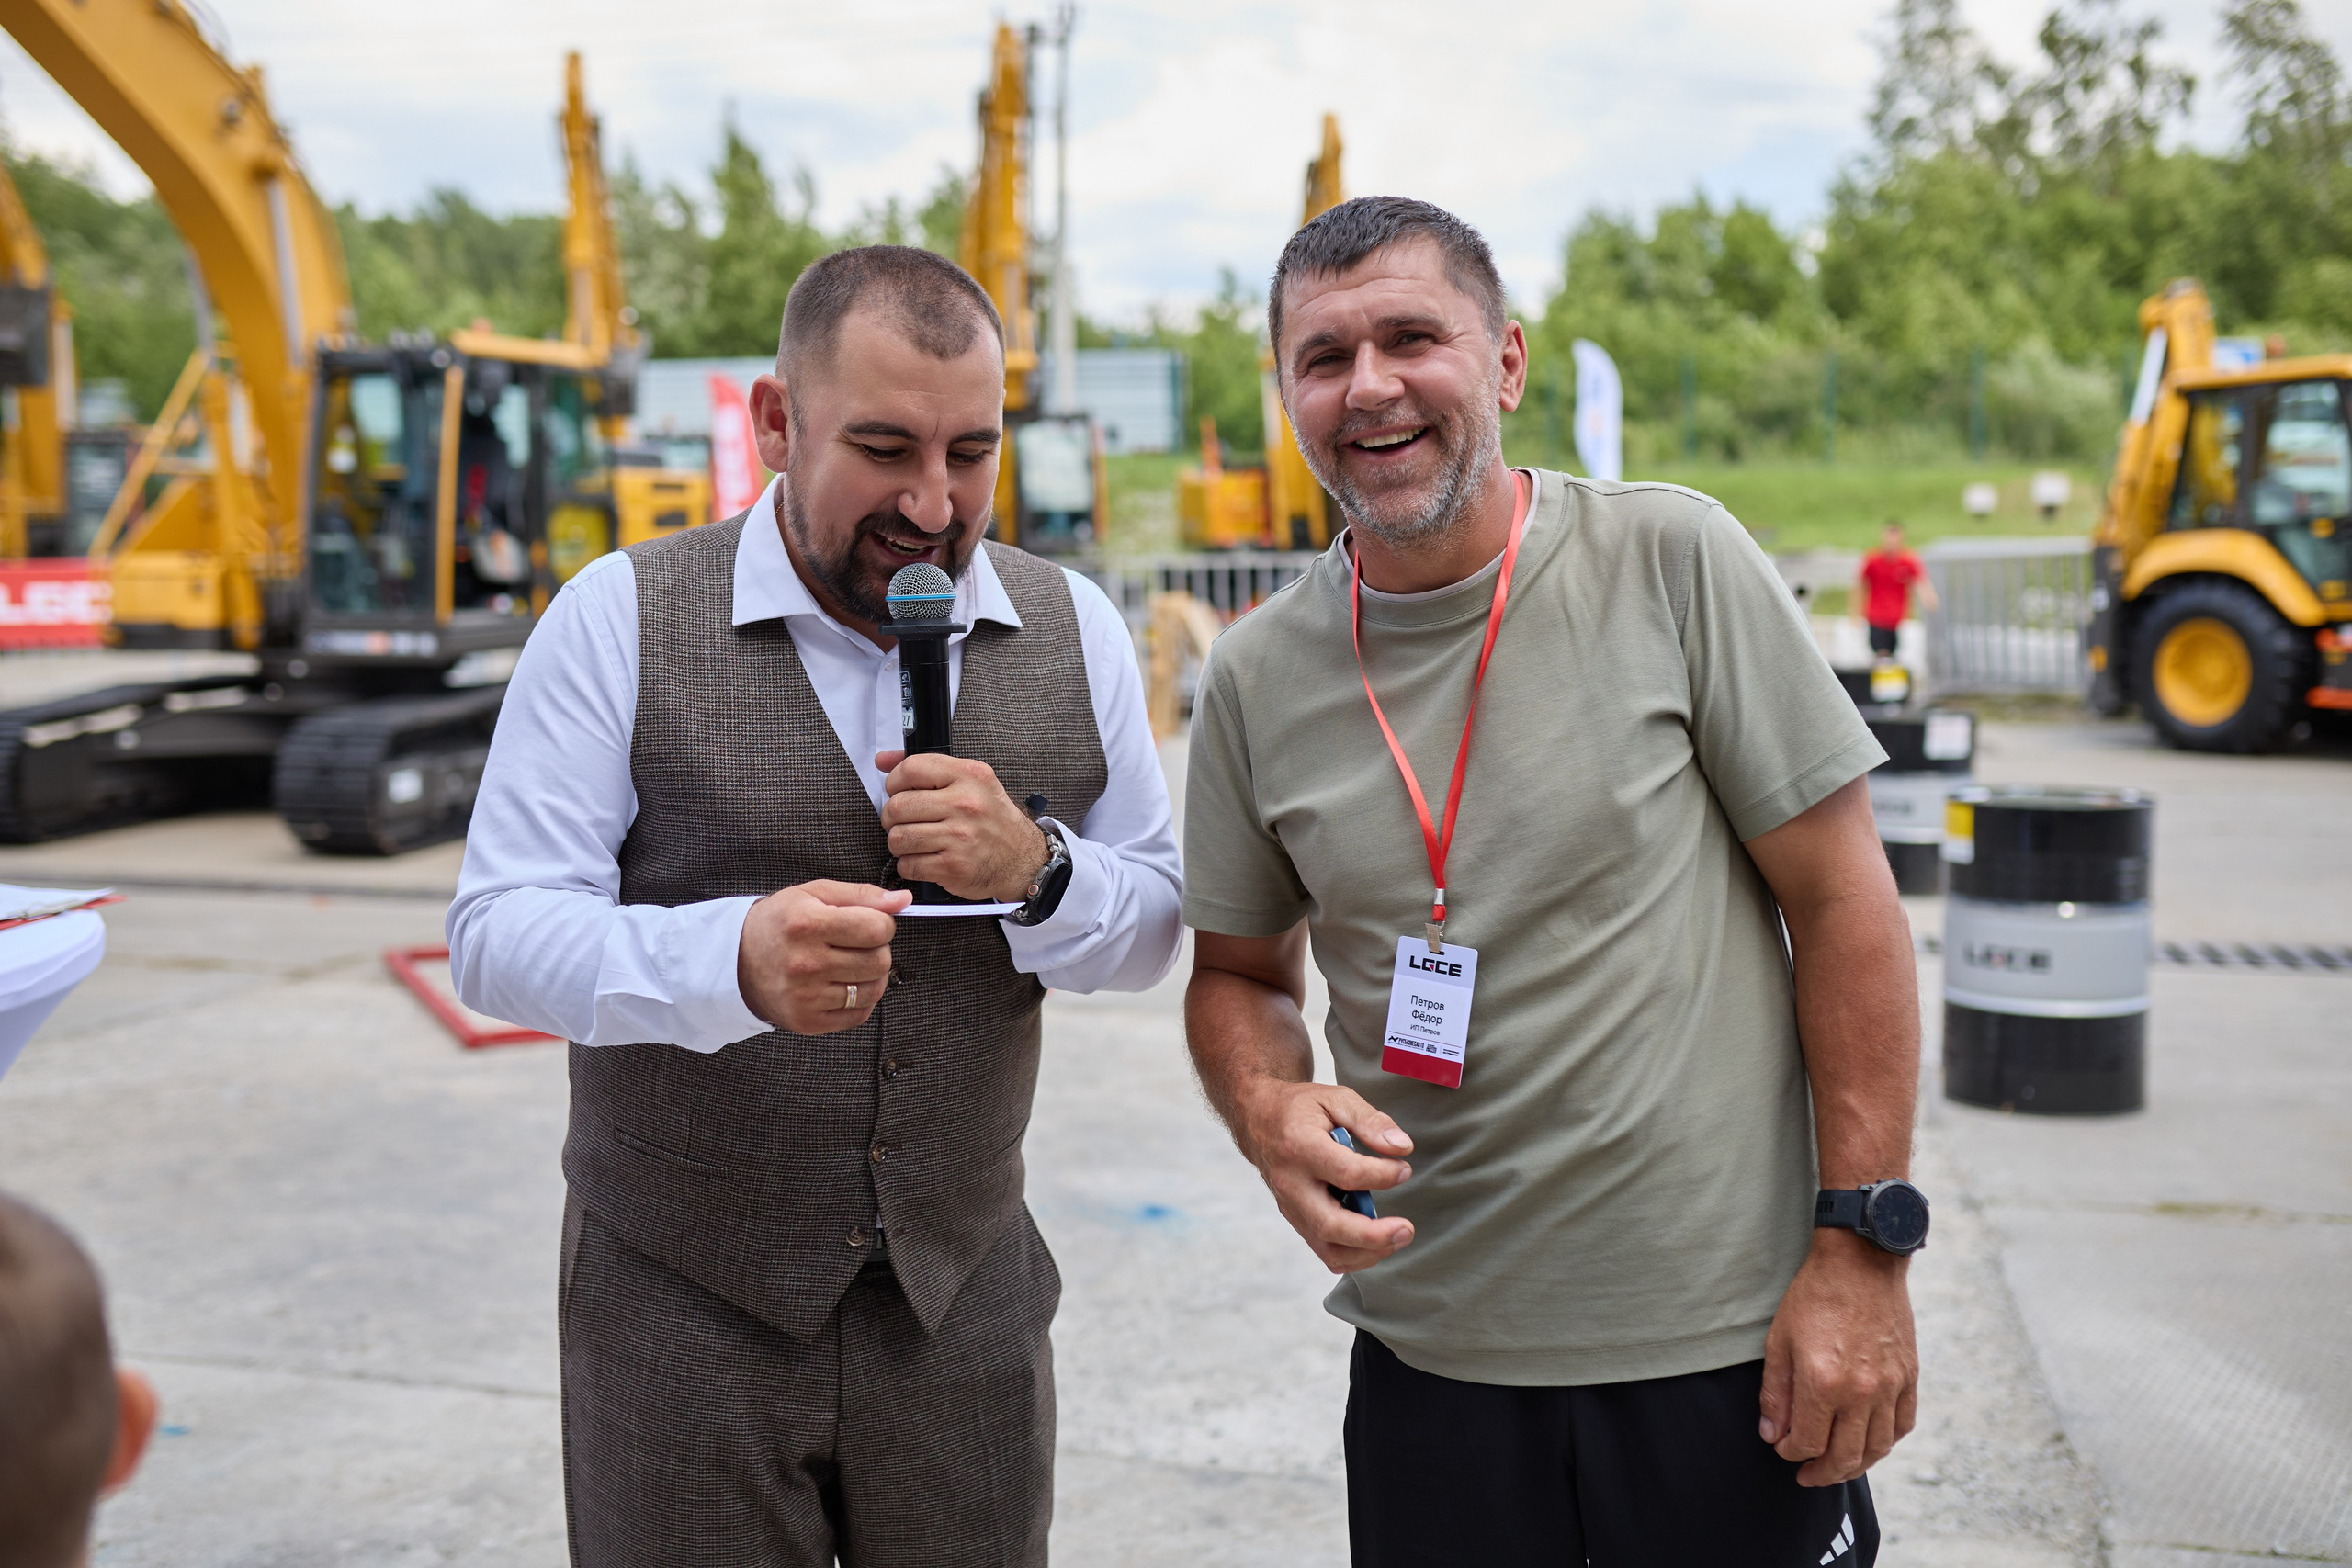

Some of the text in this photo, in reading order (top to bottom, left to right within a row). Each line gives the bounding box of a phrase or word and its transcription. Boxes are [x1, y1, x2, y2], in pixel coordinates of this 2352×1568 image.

[1409, 955, 1462, 977] LGCE
[1411, 995, 1444, 1010] Петров
[1412, 1010, 1442, 1026] Фёдор
[1420, 1026, 1440, 1035] Петров
